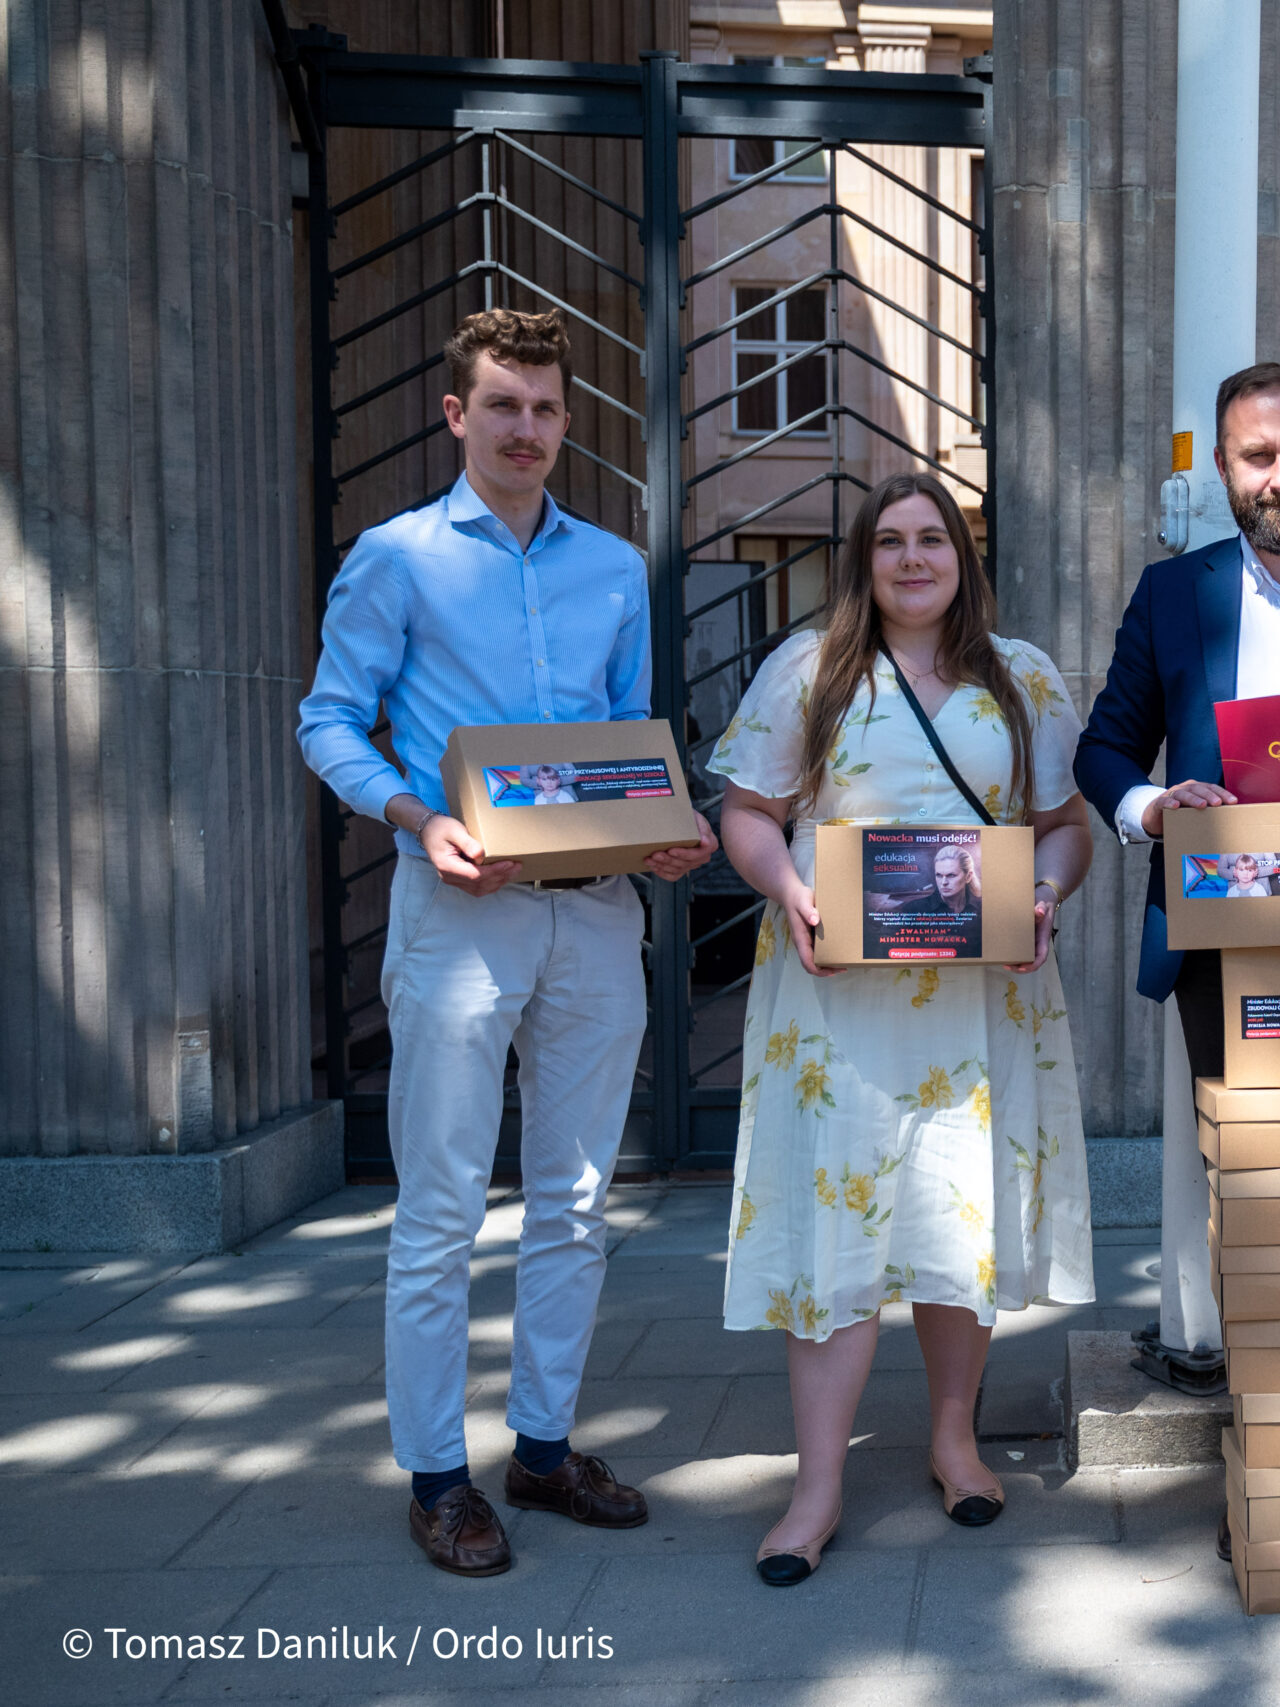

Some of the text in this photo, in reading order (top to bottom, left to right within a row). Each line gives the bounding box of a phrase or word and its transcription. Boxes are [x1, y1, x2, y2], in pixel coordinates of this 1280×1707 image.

[574, 767, 616, 776] PRZYMUSOWEJ
[868, 833, 977, 844] Nowacka musi odejść!
[874, 853, 916, 863] edukacja
[873, 863, 919, 872] seksualna
[924, 936, 967, 944] NOWACKĄ
